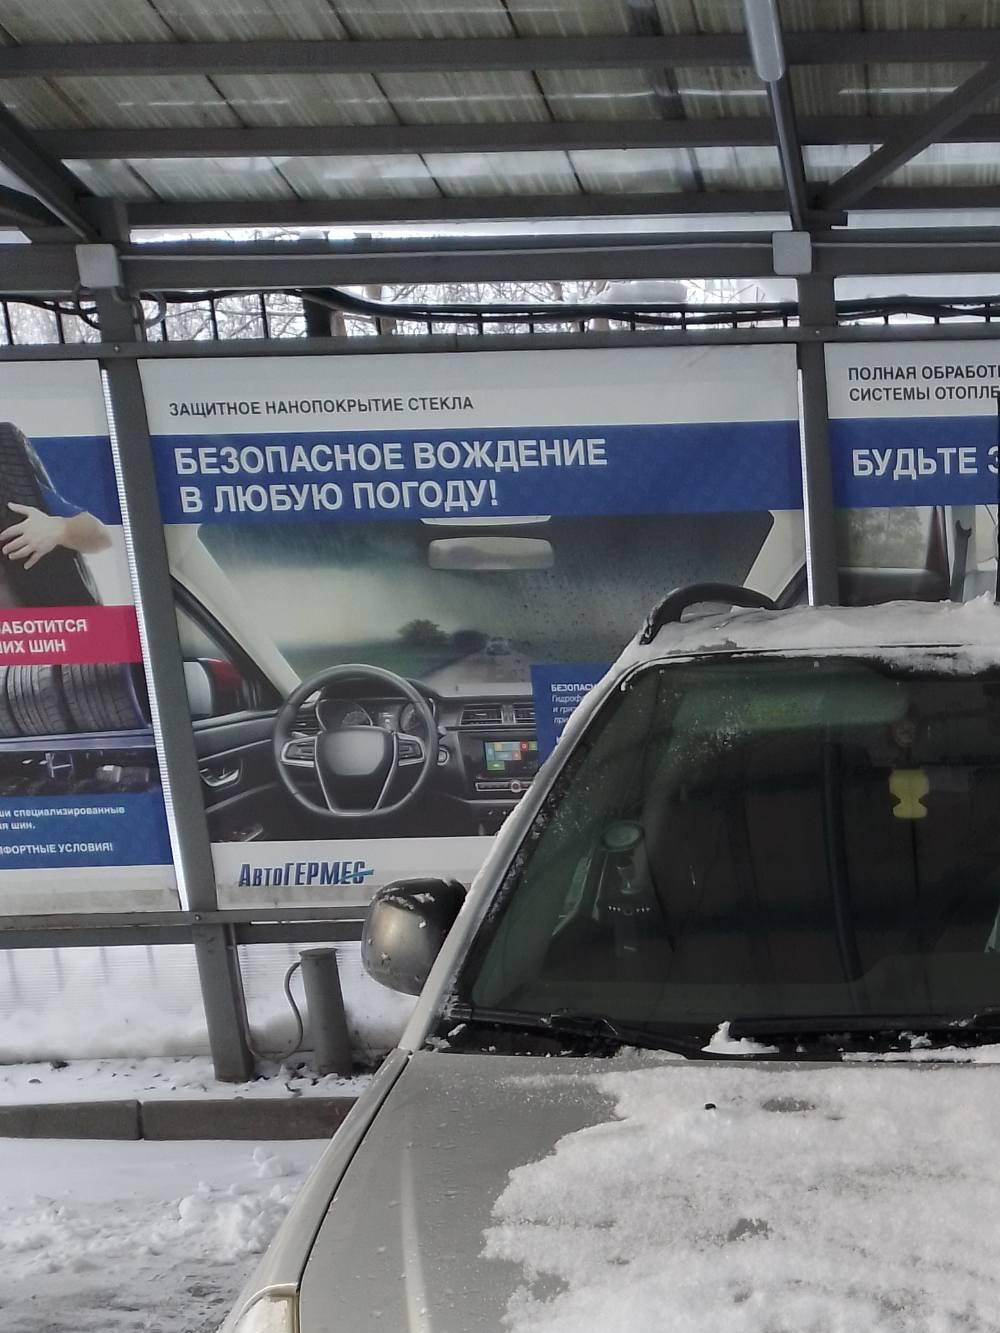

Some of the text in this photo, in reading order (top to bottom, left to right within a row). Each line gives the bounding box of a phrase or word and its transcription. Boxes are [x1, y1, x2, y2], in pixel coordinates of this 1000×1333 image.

[848, 366, 917, 381] ПОЛНАЯ
[849, 386, 931, 402] СИСТЕМЫ
[169, 396, 474, 418] ЗАЩИТНОЕ НАНОПОКРЫТИЕ СТЕКЛА
[174, 438, 608, 475] БЕЗОПАСНОЕ ВОЖДЕНИЕ
[852, 446, 978, 480] БУДЬТЕ
[179, 479, 499, 513] В ЛЮБУЮ ПОГОДУ!
[0, 618, 88, 635] АБОТИТСЯ
[28, 639, 67, 654] ШИН
[13, 806, 126, 818] специализированные
[11, 822, 36, 830] шин.
[0, 842, 113, 856] ФОРТНЫЕ УСЛОВИЯ!
